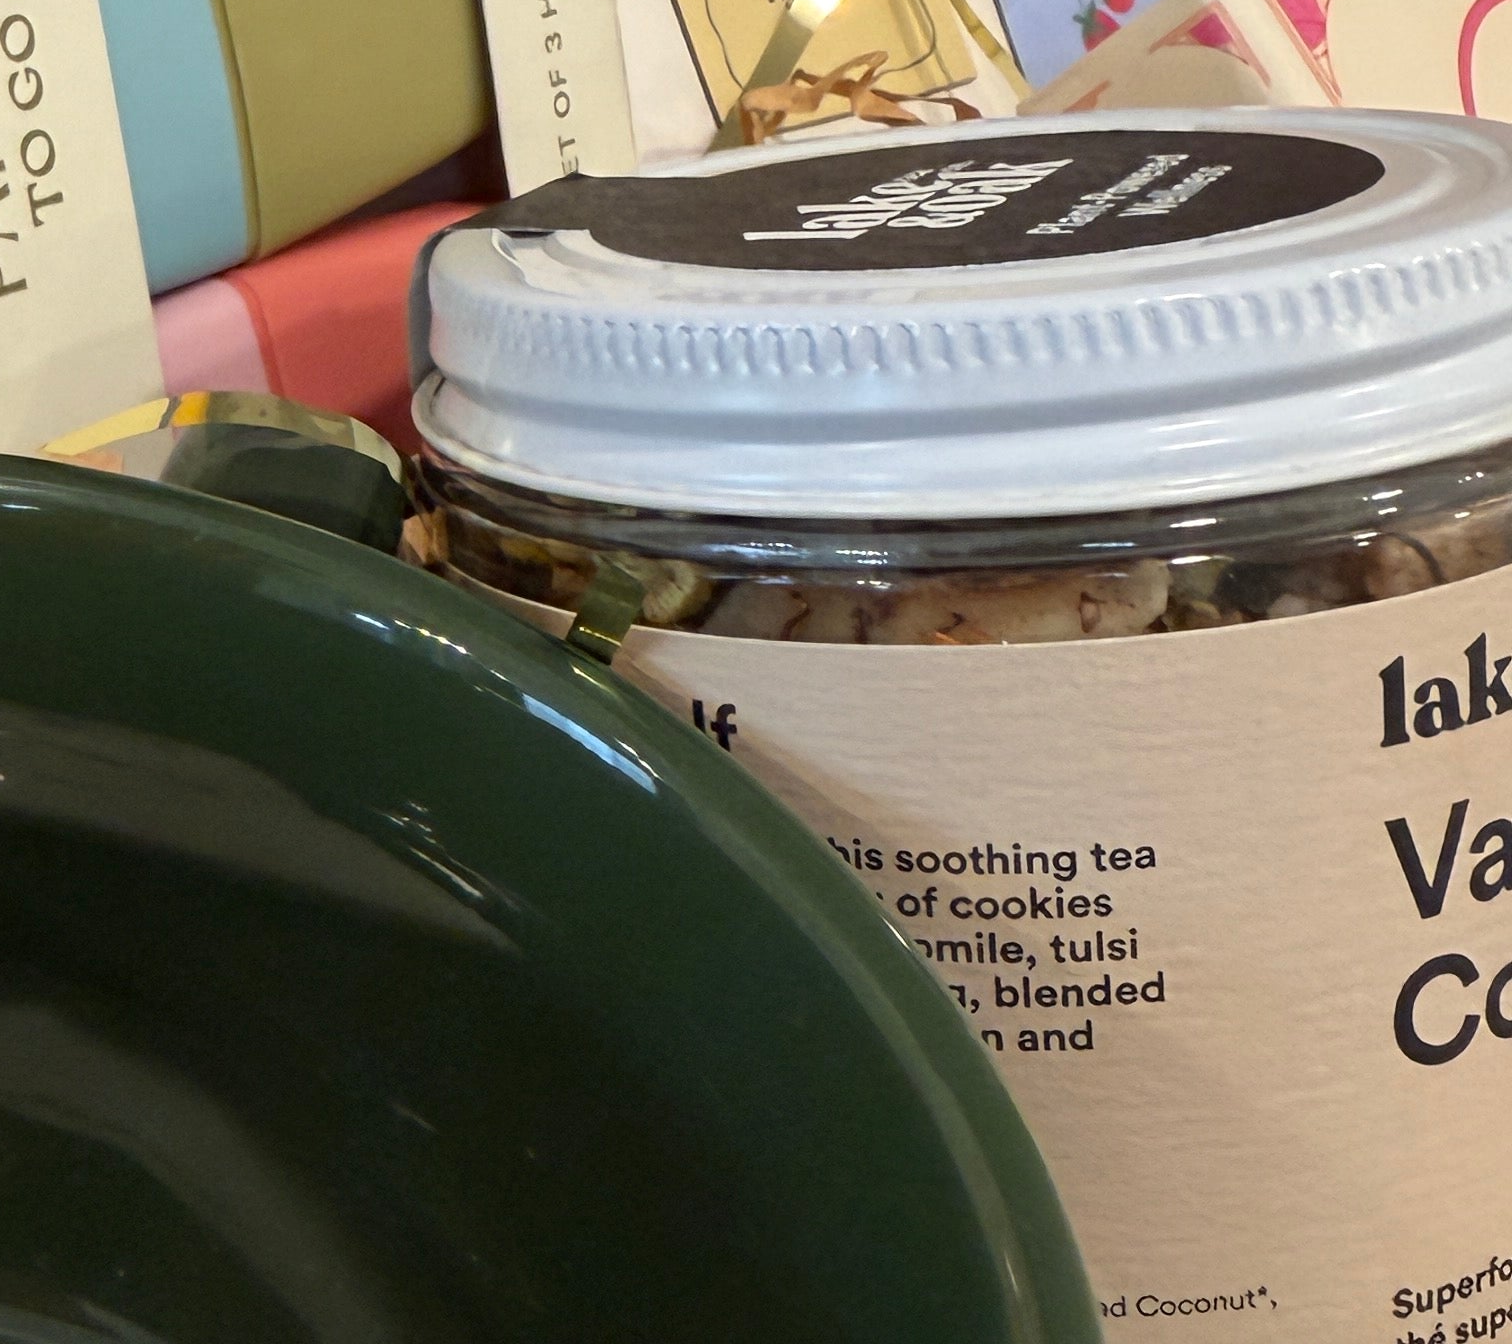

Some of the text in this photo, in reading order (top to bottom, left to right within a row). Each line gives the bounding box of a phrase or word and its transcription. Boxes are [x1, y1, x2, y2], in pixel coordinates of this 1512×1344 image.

[544, 30, 563, 53] 3
[549, 68, 572, 120] OF
[17, 128, 64, 228] TO
[894, 842, 1078, 882] soothing
[1089, 842, 1157, 873] tea
[896, 886, 1114, 920] of cookies
[1049, 927, 1139, 964] tulsi
[994, 970, 1166, 1009] blended
[1017, 1019, 1095, 1053] and
